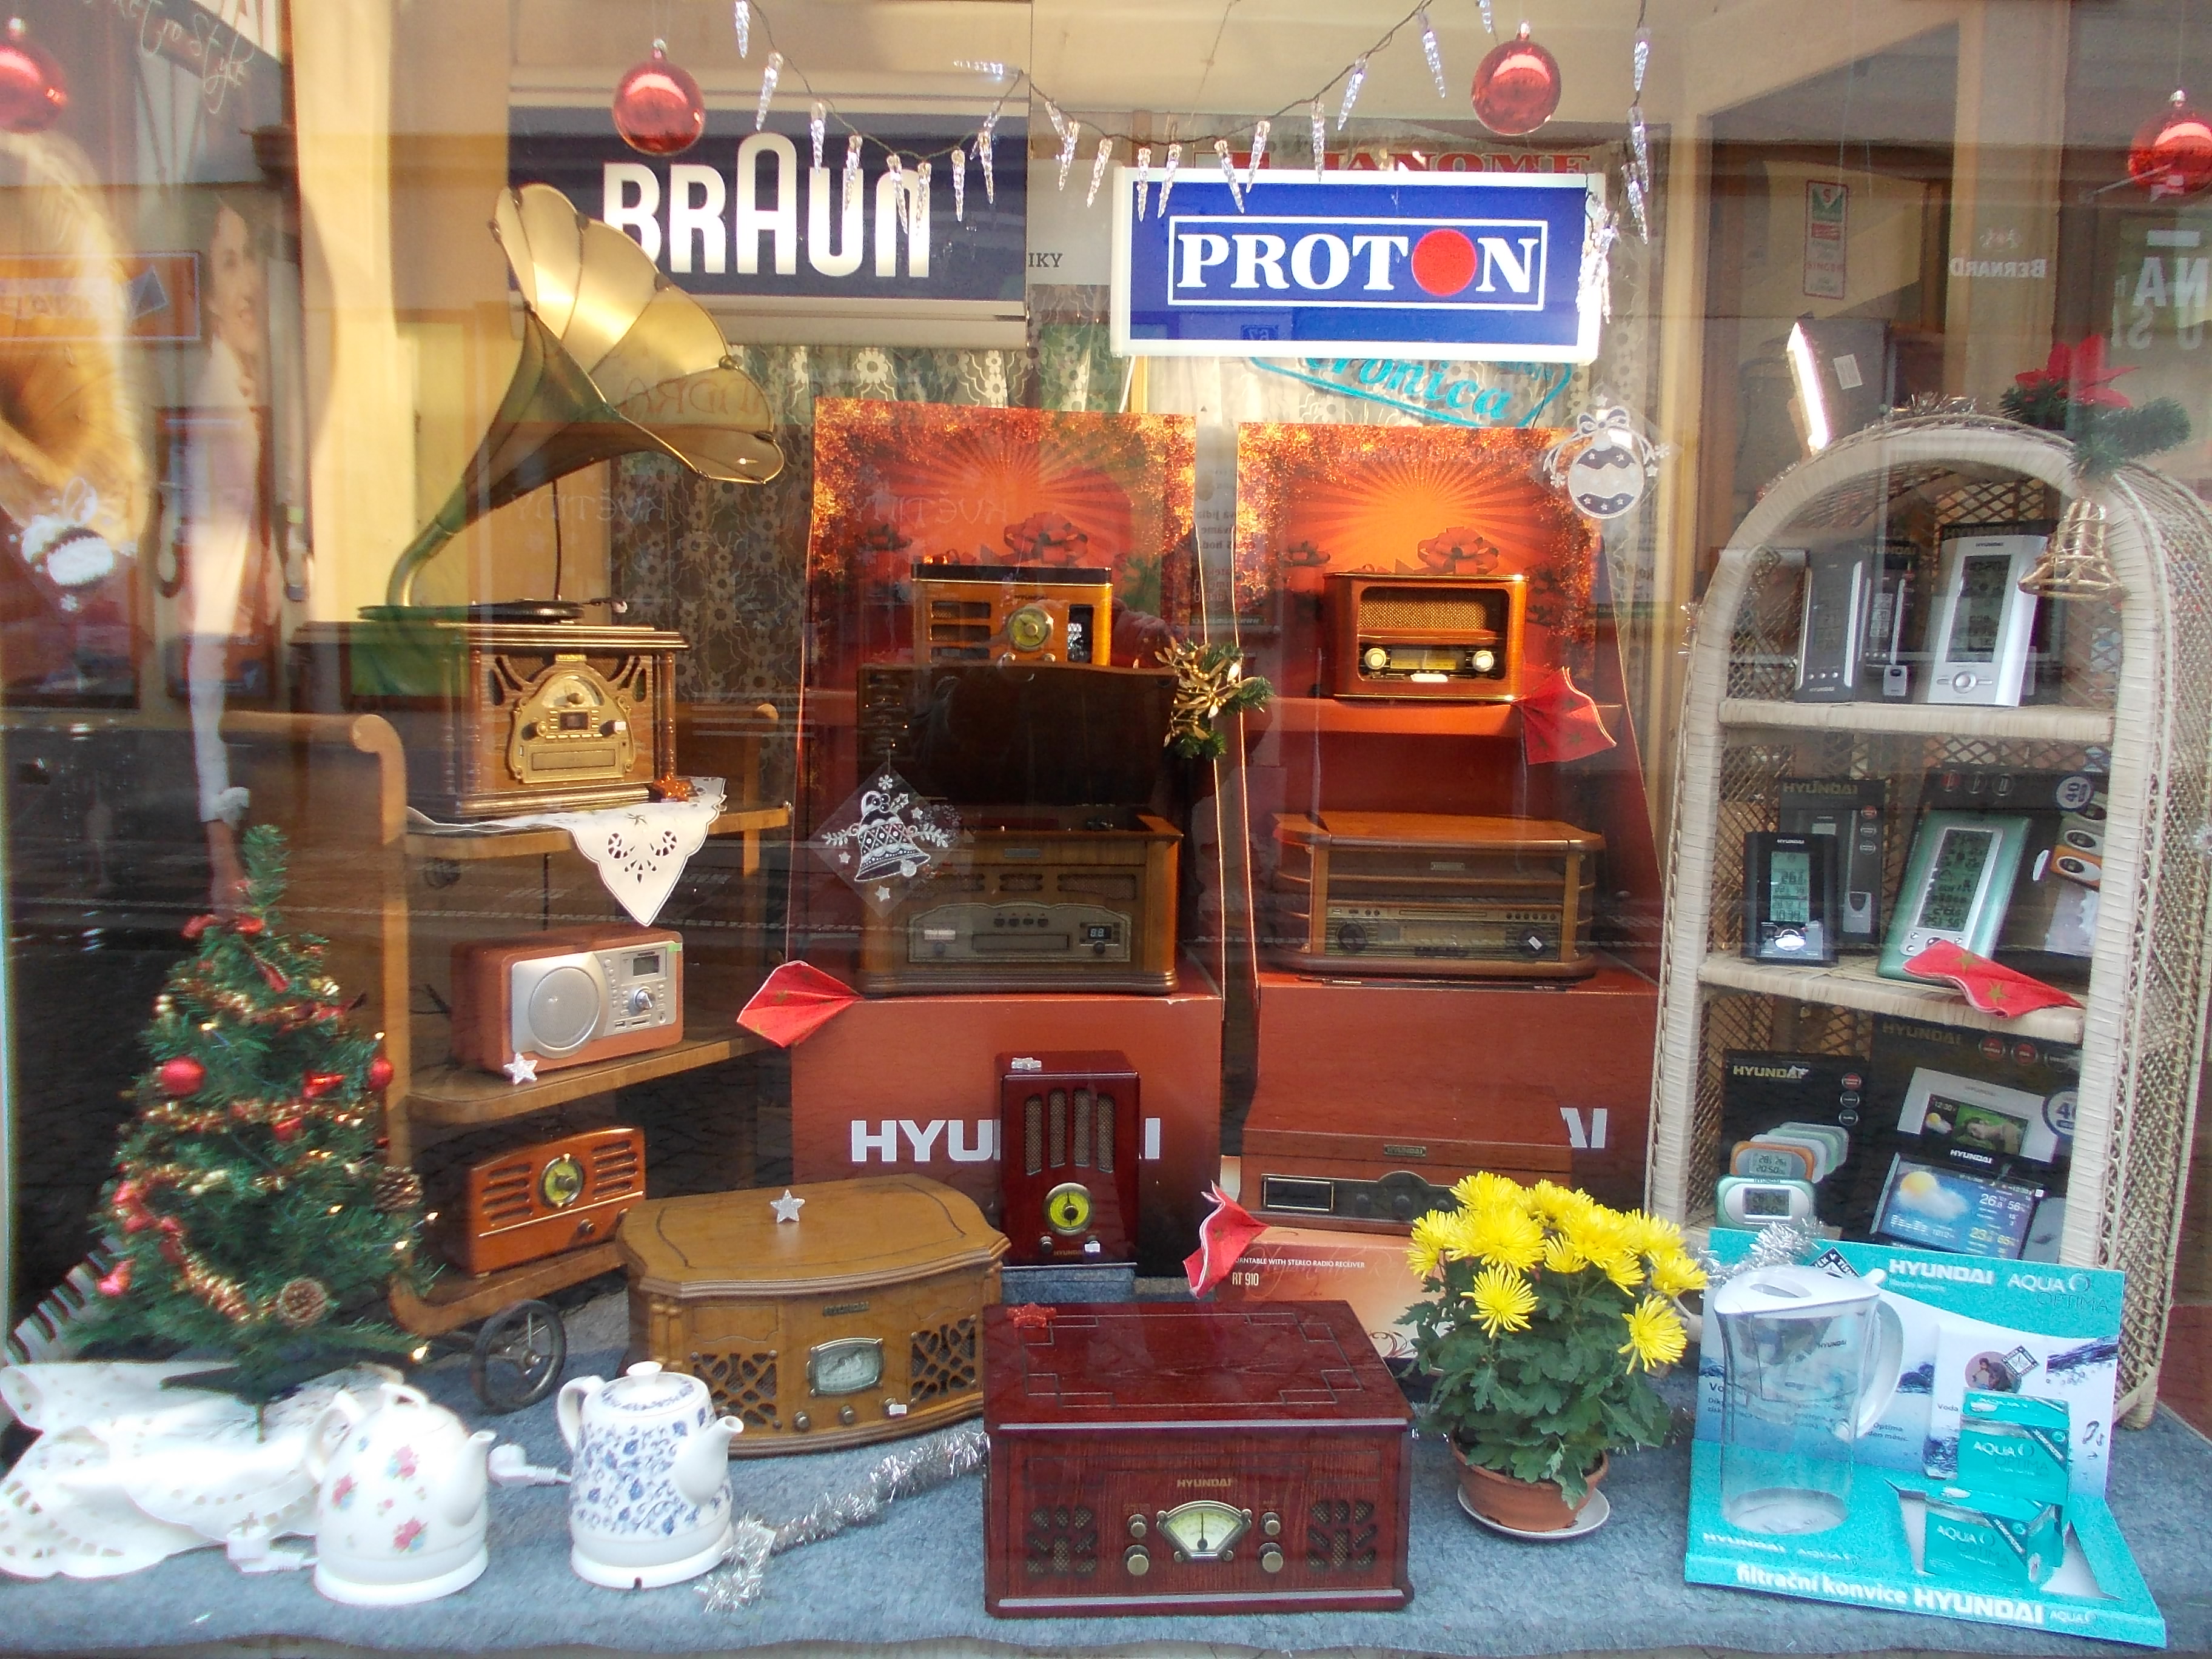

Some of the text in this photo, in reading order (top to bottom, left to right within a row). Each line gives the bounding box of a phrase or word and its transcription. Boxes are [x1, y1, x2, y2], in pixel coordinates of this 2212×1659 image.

[603, 133, 931, 278] BRAUN
[1232, 1272, 1259, 1286] RT 910
[1888, 1258, 1995, 1285] HYUNDAI
[1176, 1478, 1232, 1488] HYUNDAI
[1736, 1563, 1820, 1593] filtrační
[1822, 1575, 1908, 1605] konvice
[1914, 1586, 2045, 1624] HYUNDAI
